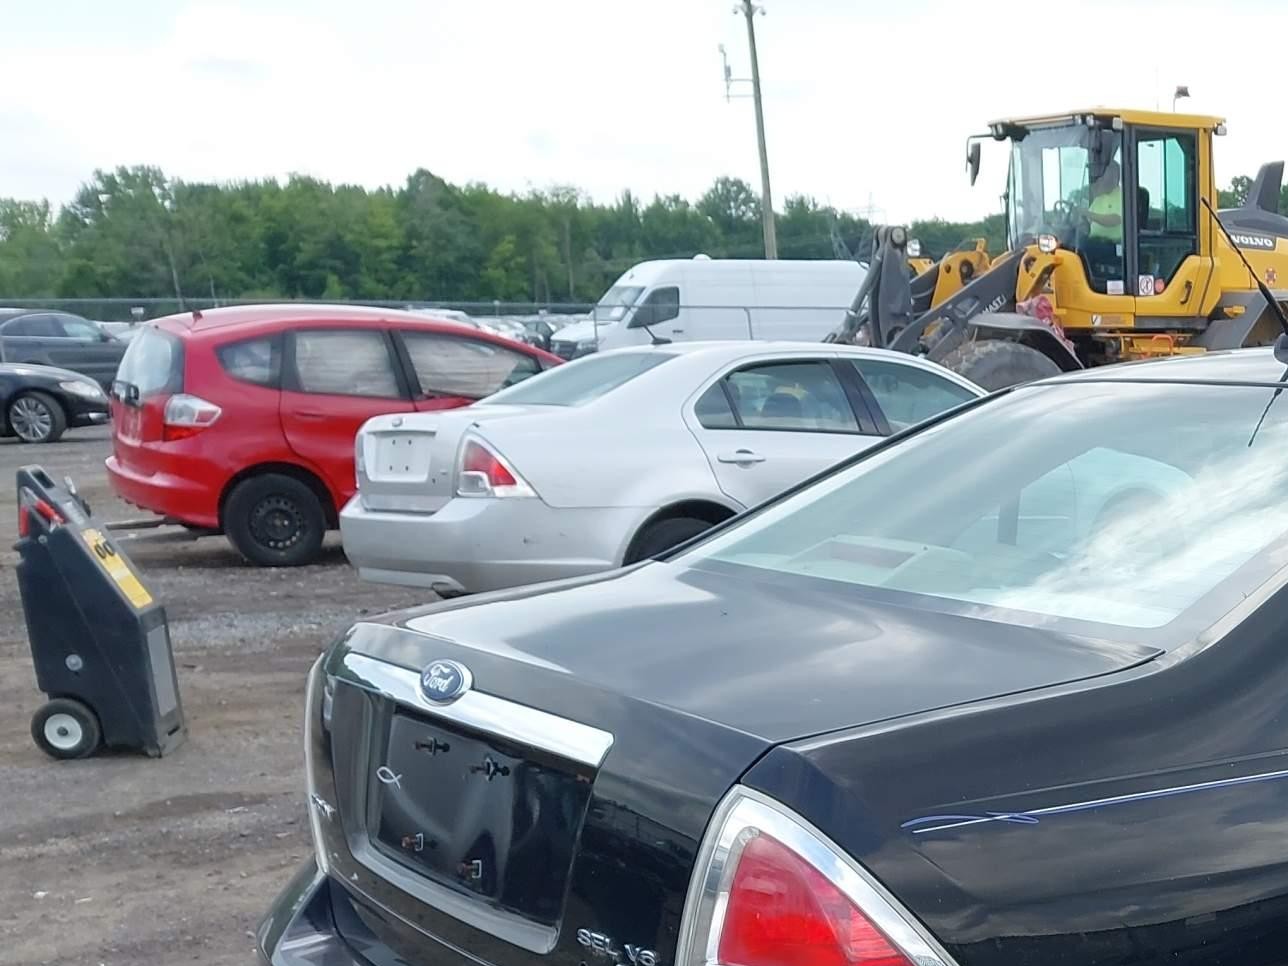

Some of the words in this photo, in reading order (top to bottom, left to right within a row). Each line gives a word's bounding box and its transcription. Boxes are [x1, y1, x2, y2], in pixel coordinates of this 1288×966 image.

[1230, 234, 1273, 248] VOLVO
[423, 663, 455, 692] Ford
[577, 928, 619, 957] SEL
